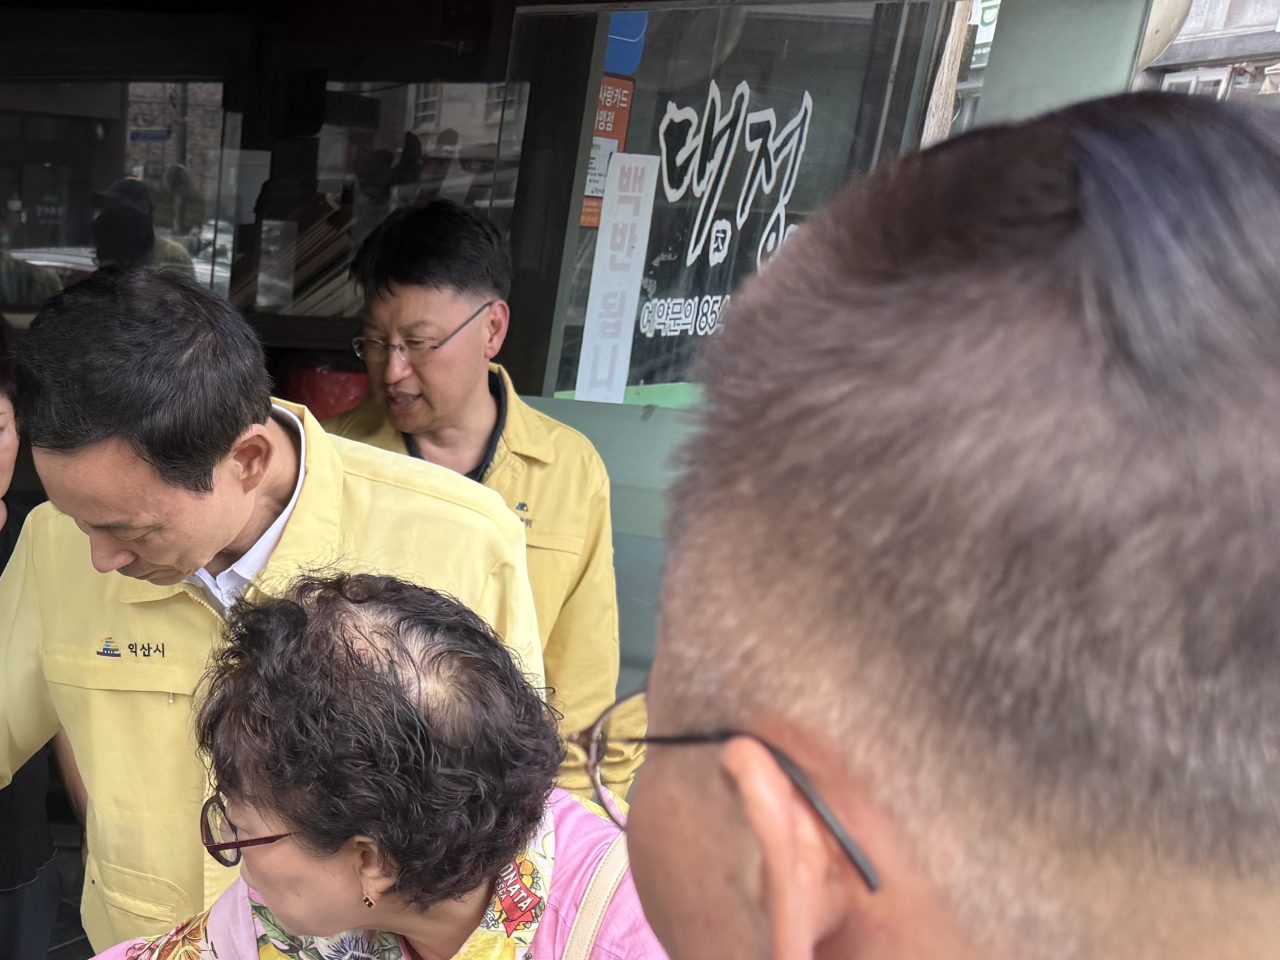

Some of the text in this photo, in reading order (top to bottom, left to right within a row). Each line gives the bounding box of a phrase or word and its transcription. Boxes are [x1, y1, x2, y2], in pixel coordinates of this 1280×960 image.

[640, 296, 698, 337] 예약문의
[127, 642, 166, 658] 익산시
[499, 863, 533, 912] ONATA
